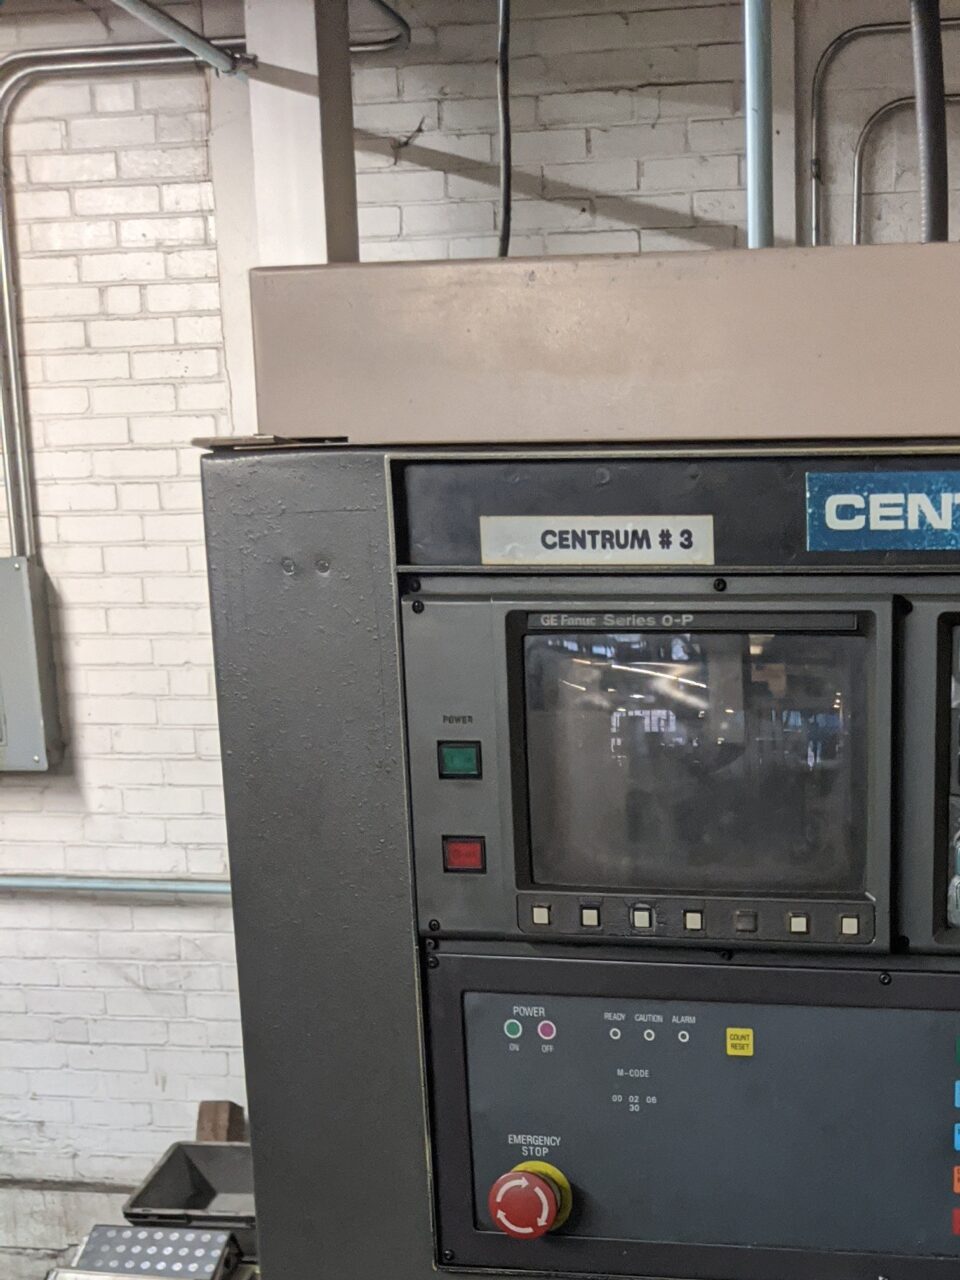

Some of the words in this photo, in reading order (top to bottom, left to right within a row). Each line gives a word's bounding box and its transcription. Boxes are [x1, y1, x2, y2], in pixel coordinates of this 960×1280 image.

[540, 529, 652, 550] CENTRUM
[658, 530, 671, 549] #
[680, 530, 693, 549] 3
[540, 614, 557, 626] GE
[561, 614, 595, 626] Fanuc
[603, 613, 656, 626] Series
[442, 715, 473, 724] POWER
[513, 1006, 546, 1017] POWER
[603, 1012, 626, 1022] READY
[634, 1013, 664, 1023] CAUTION
[672, 1016, 696, 1025] ALARM
[729, 1033, 751, 1042] COUNT
[509, 1043, 520, 1052] ON
[541, 1044, 554, 1053] OFF
[730, 1042, 750, 1051] RESET
[616, 1068, 650, 1078] M-CODE
[628, 1095, 640, 1103] 02
[508, 1134, 562, 1147] EMERGENCY
[522, 1147, 549, 1157] STOP
